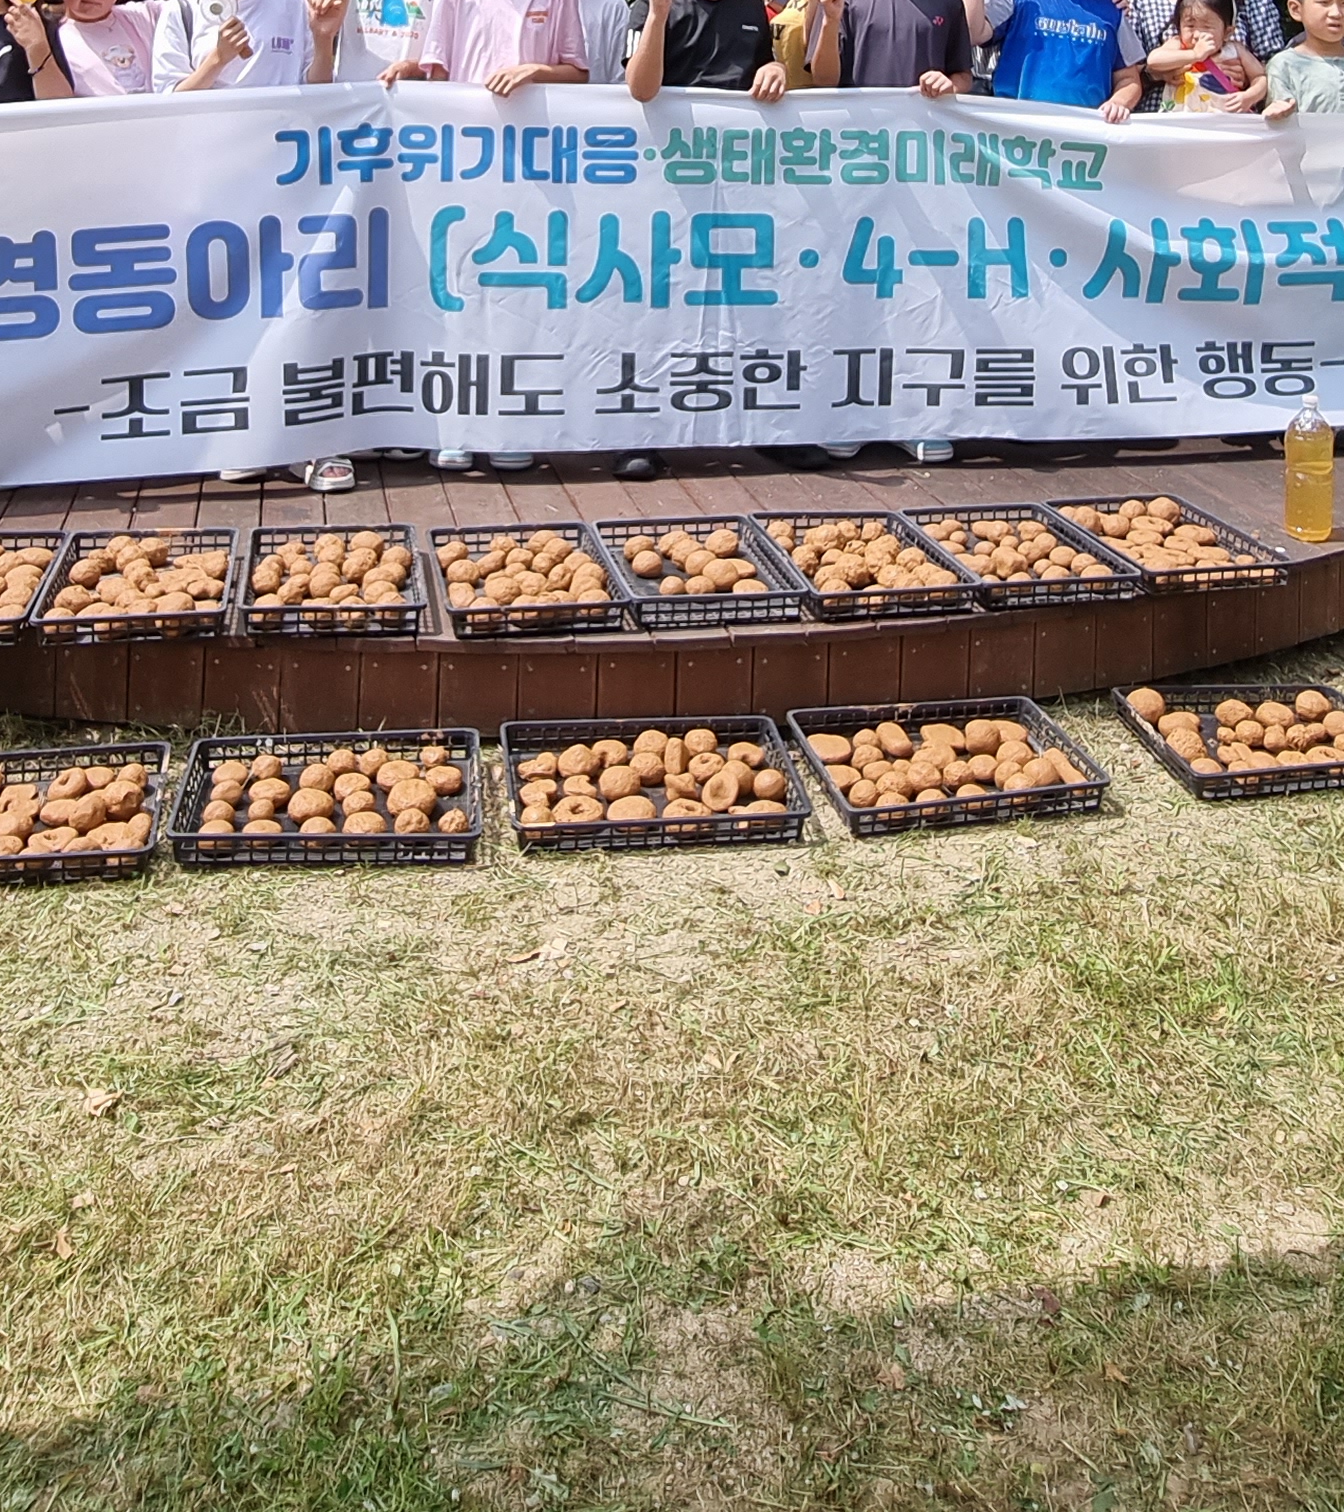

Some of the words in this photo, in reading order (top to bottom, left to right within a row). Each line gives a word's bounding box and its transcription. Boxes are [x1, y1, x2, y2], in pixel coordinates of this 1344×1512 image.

[283, 351, 564, 427] 불편해도
[595, 348, 807, 414] 소중한
[831, 348, 1035, 408] 지구를
[1061, 343, 1178, 405] 위한
